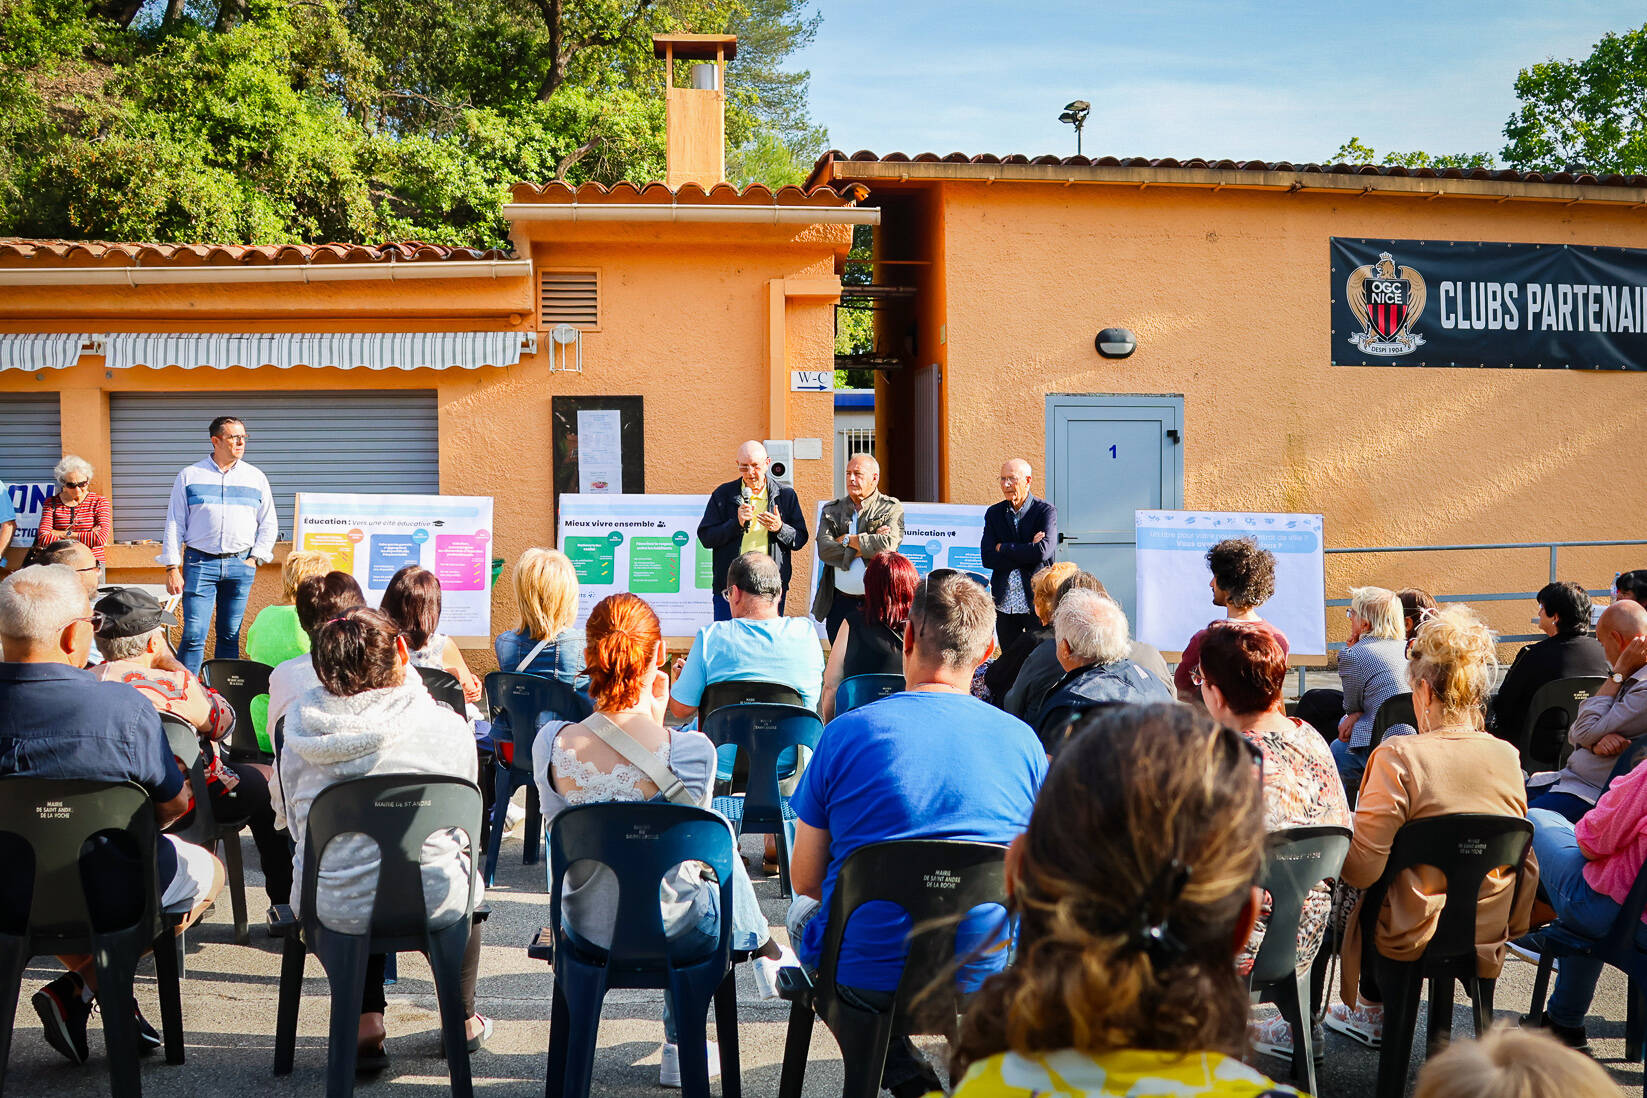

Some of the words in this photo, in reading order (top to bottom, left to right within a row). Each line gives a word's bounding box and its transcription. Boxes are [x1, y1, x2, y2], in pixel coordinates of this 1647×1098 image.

[1371, 281, 1402, 293] OGC
[1372, 293, 1403, 304] NICE
[1440, 281, 1519, 331] CLUBS
[798, 371, 828, 384] W-C
[1109, 444, 1117, 459] 1
[614, 520, 655, 528] ensemble
